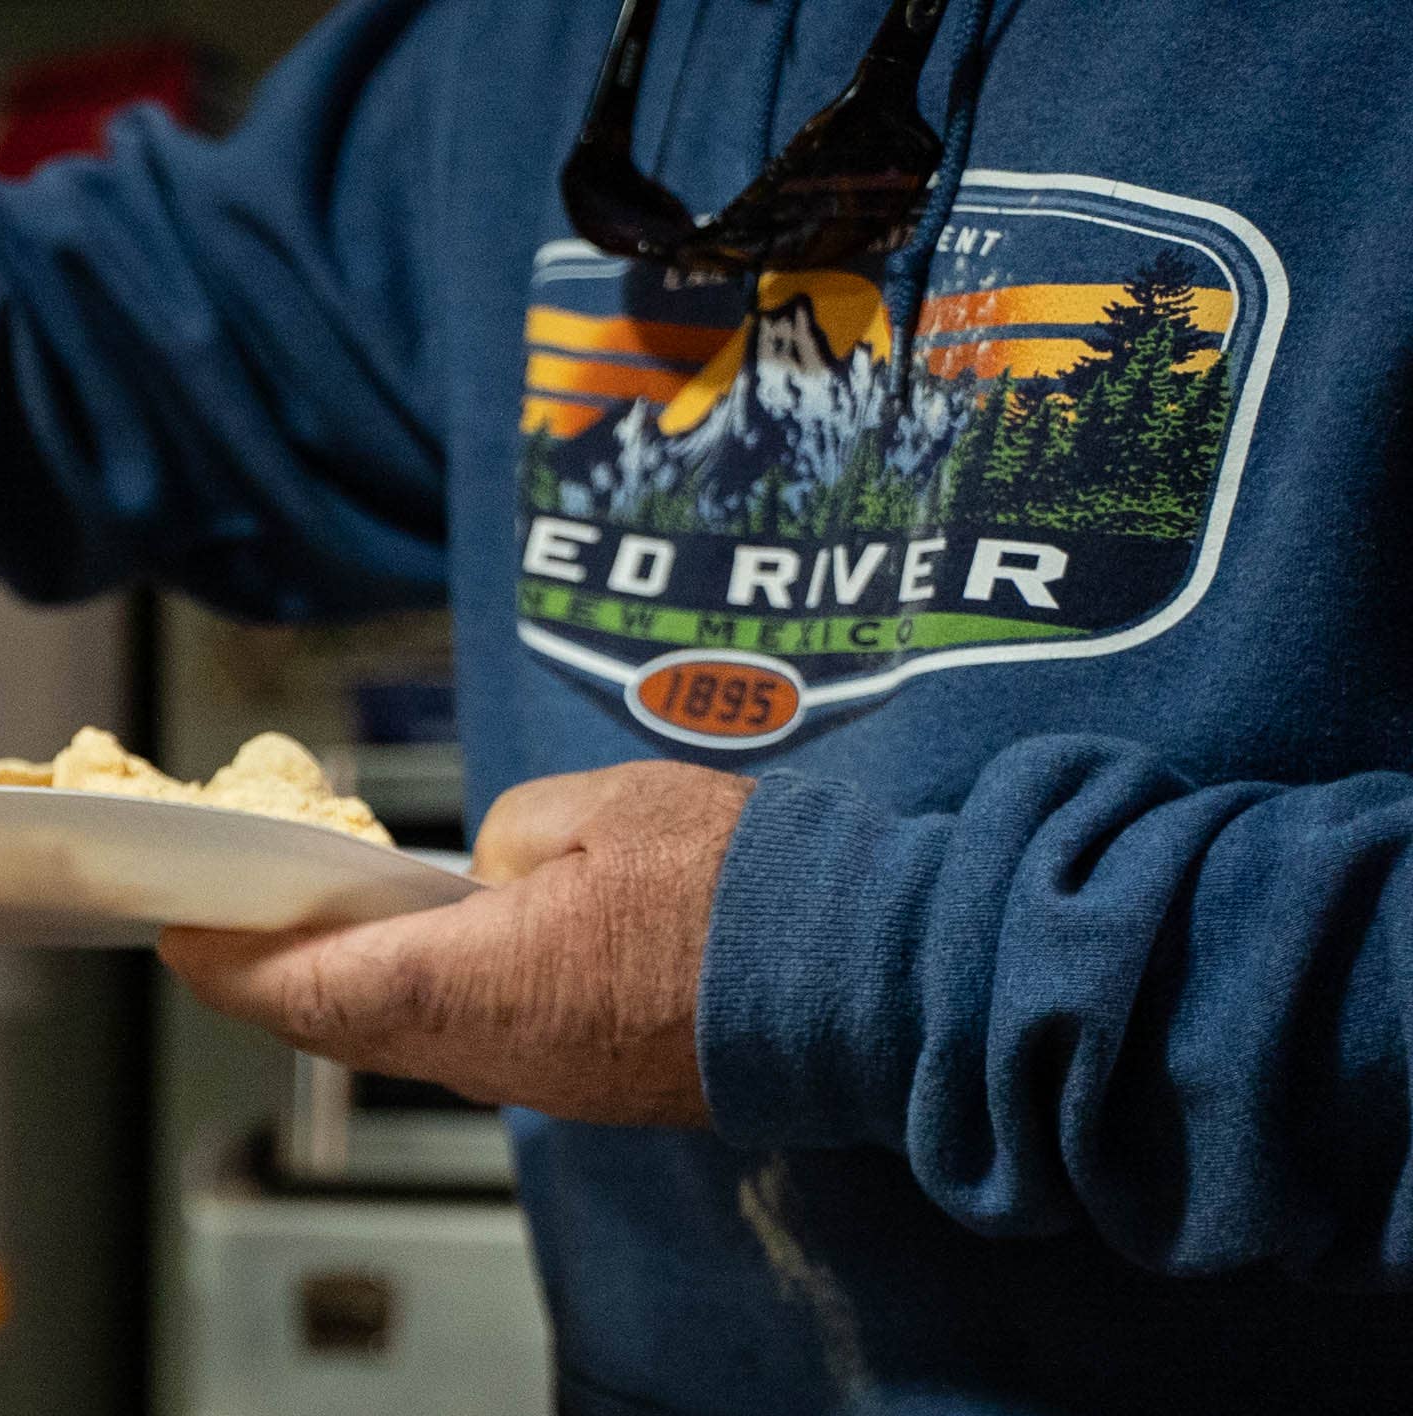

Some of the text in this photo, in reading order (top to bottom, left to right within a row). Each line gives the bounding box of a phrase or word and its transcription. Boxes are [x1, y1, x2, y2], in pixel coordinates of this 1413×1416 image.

[726, 537, 1069, 611] RIVER
[699, 615, 915, 653] MEXICO
[662, 666, 779, 729] 1895
